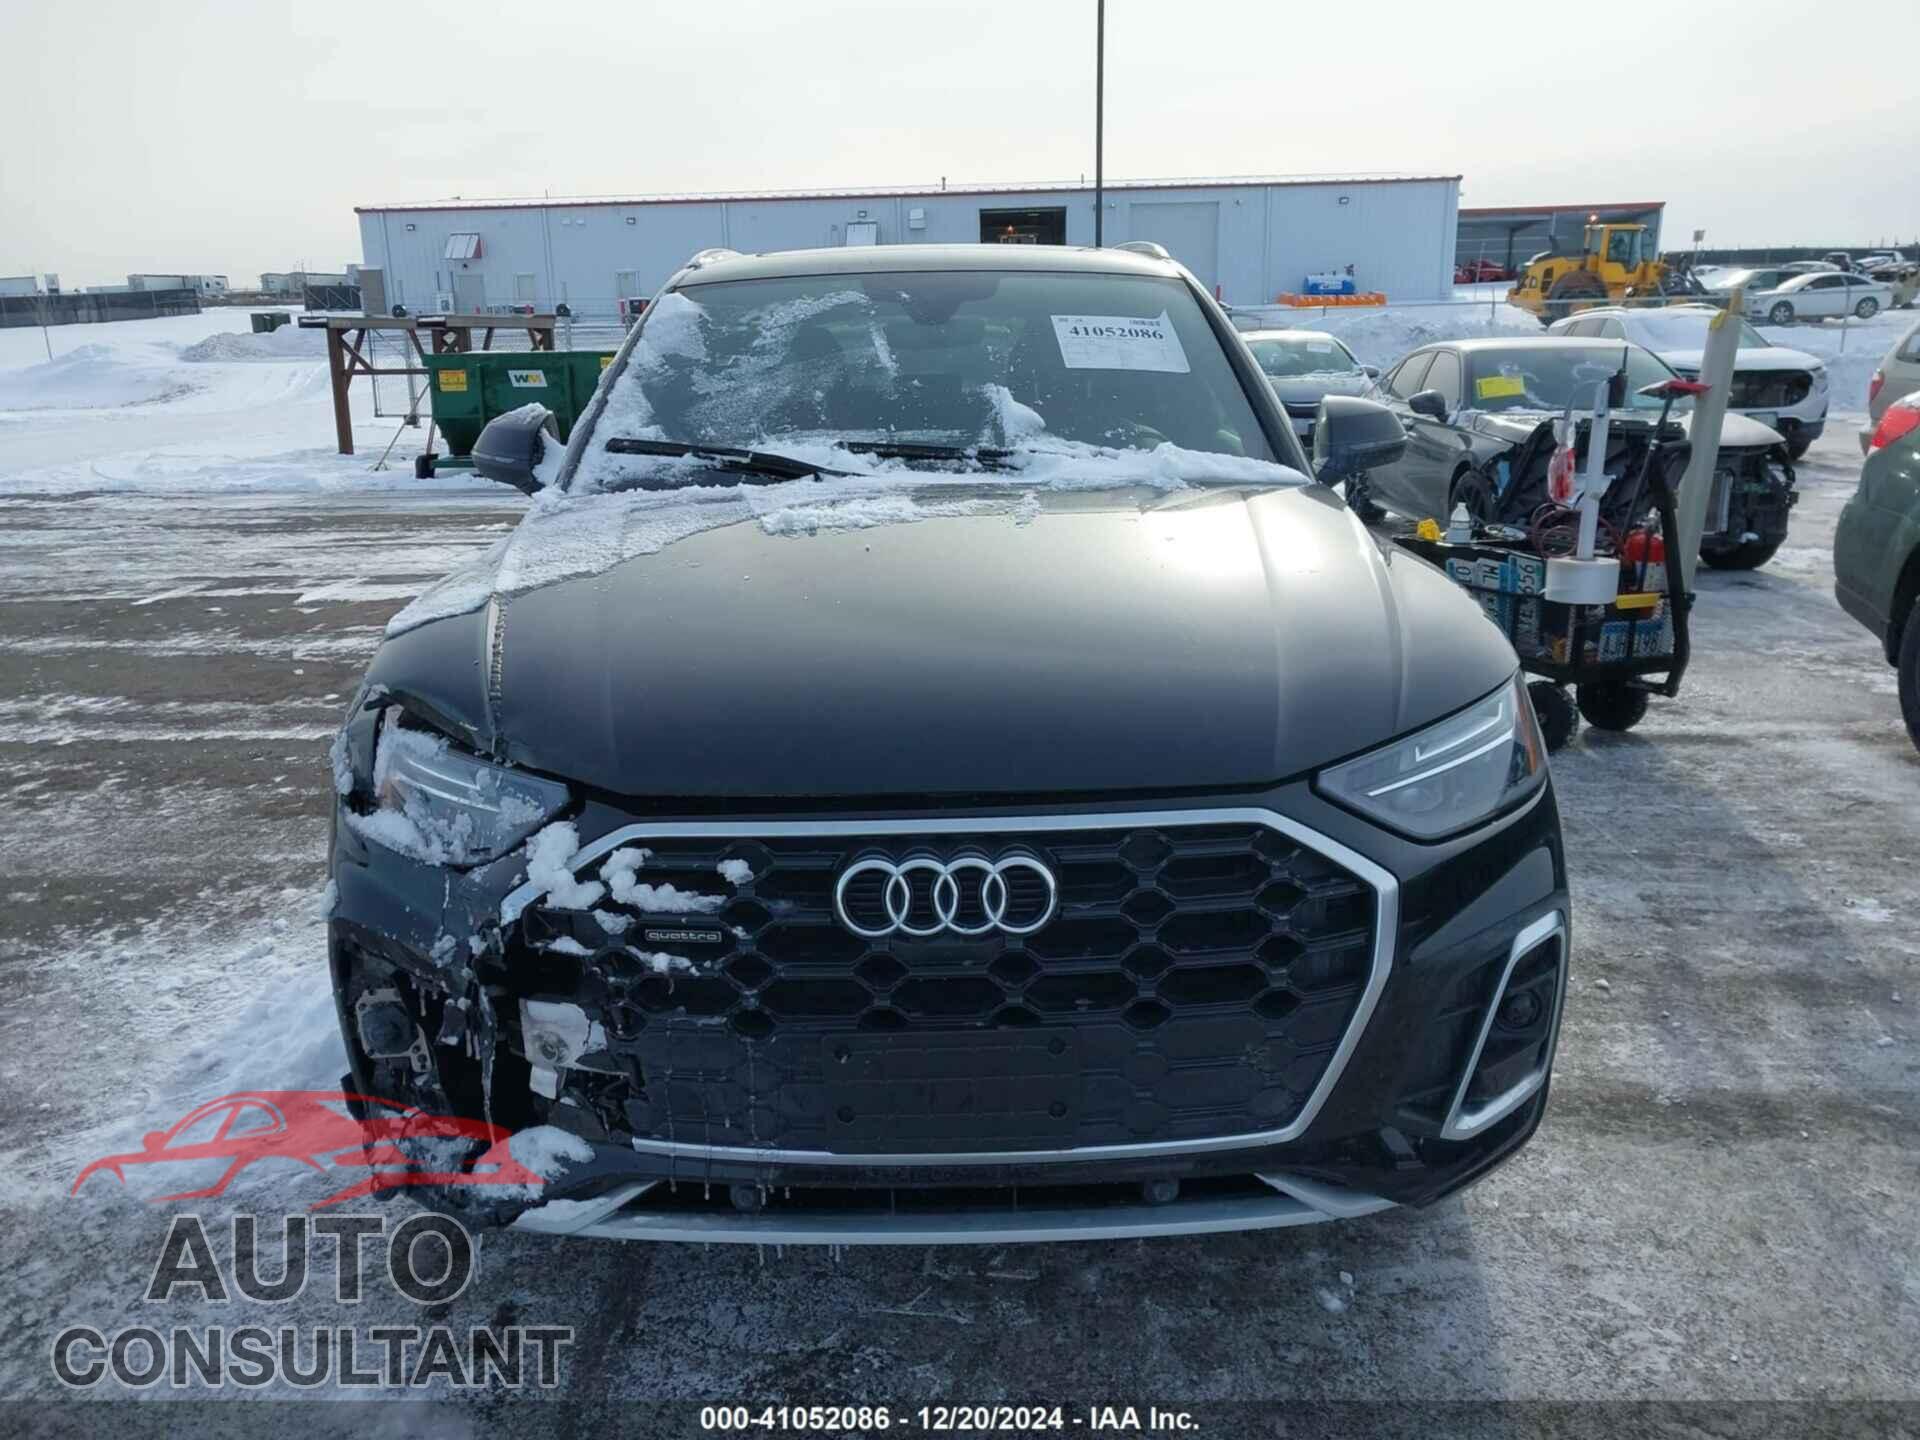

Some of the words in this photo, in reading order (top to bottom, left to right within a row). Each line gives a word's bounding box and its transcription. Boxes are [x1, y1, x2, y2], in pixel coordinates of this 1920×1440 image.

[1069, 325, 1164, 340] 41052086
[513, 374, 542, 384] WM
[647, 931, 718, 941] quattro
